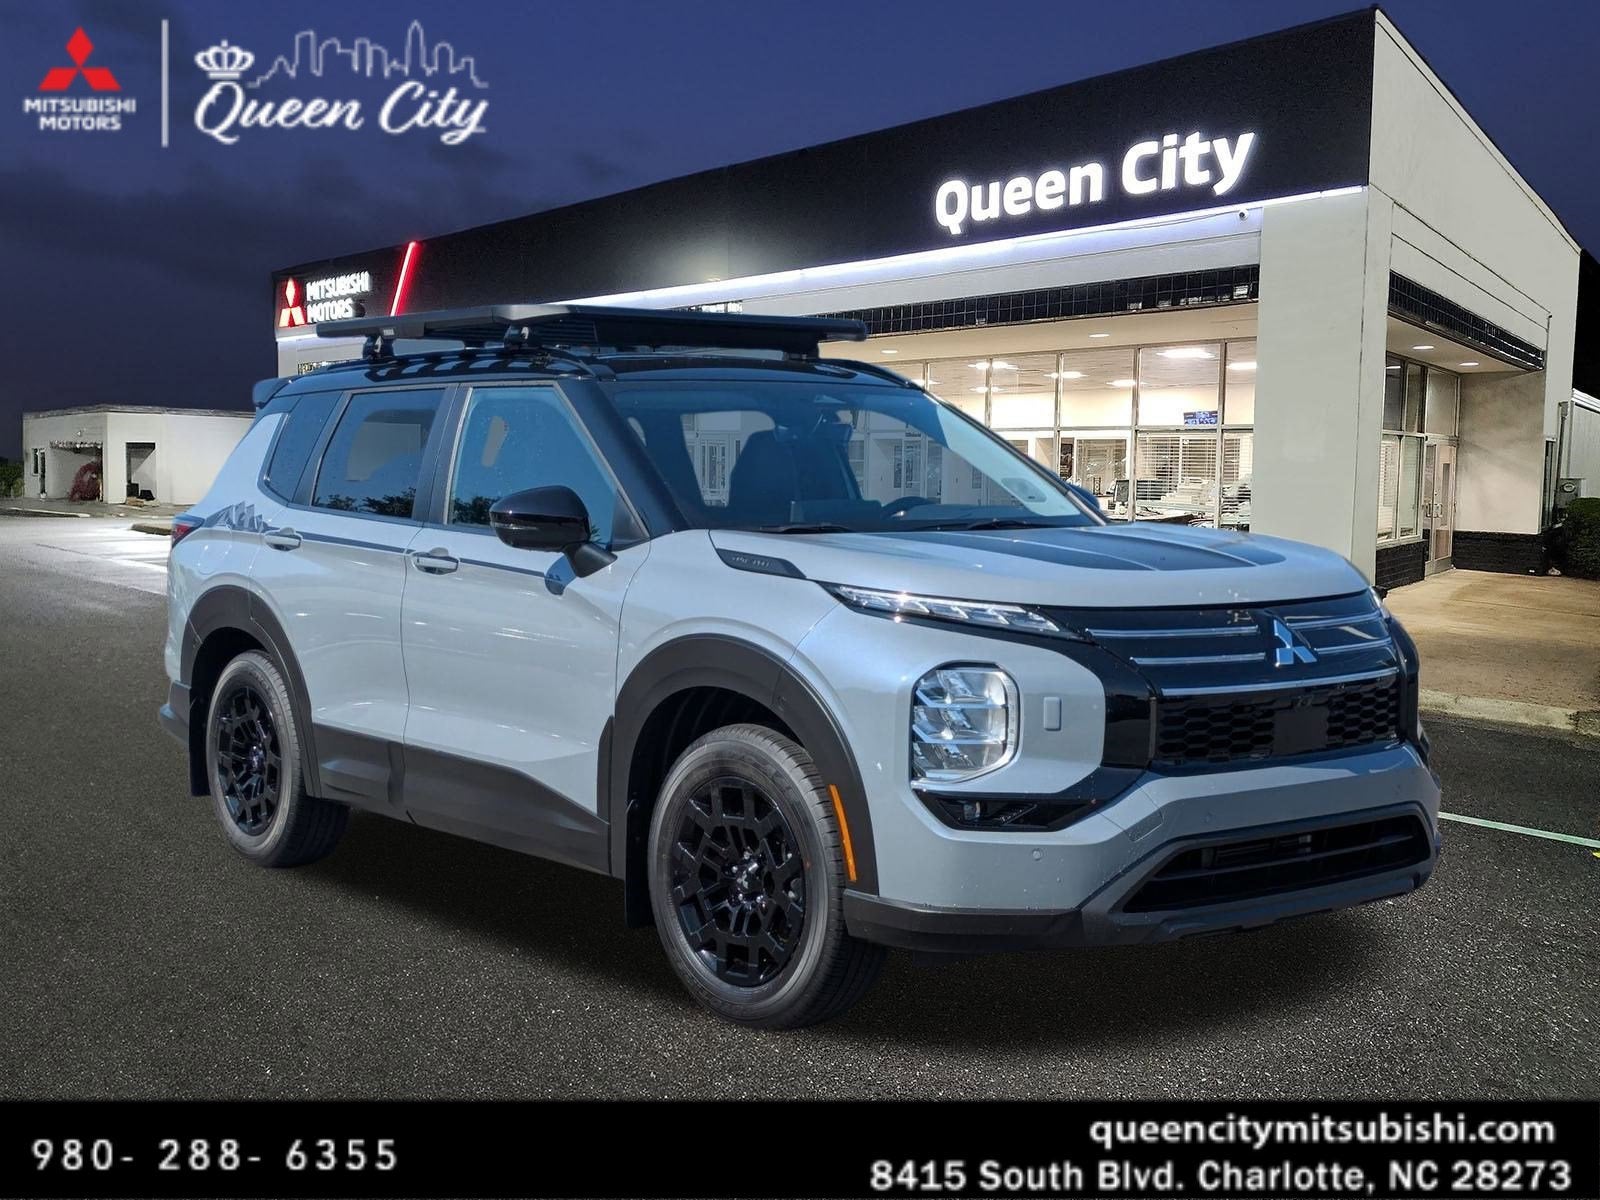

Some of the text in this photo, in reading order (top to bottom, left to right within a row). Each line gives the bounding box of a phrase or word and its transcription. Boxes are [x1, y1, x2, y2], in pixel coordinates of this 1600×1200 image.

[935, 131, 1255, 235] Queen City
[306, 271, 371, 301] MITSUBISHI
[306, 298, 354, 323] MOTORS
